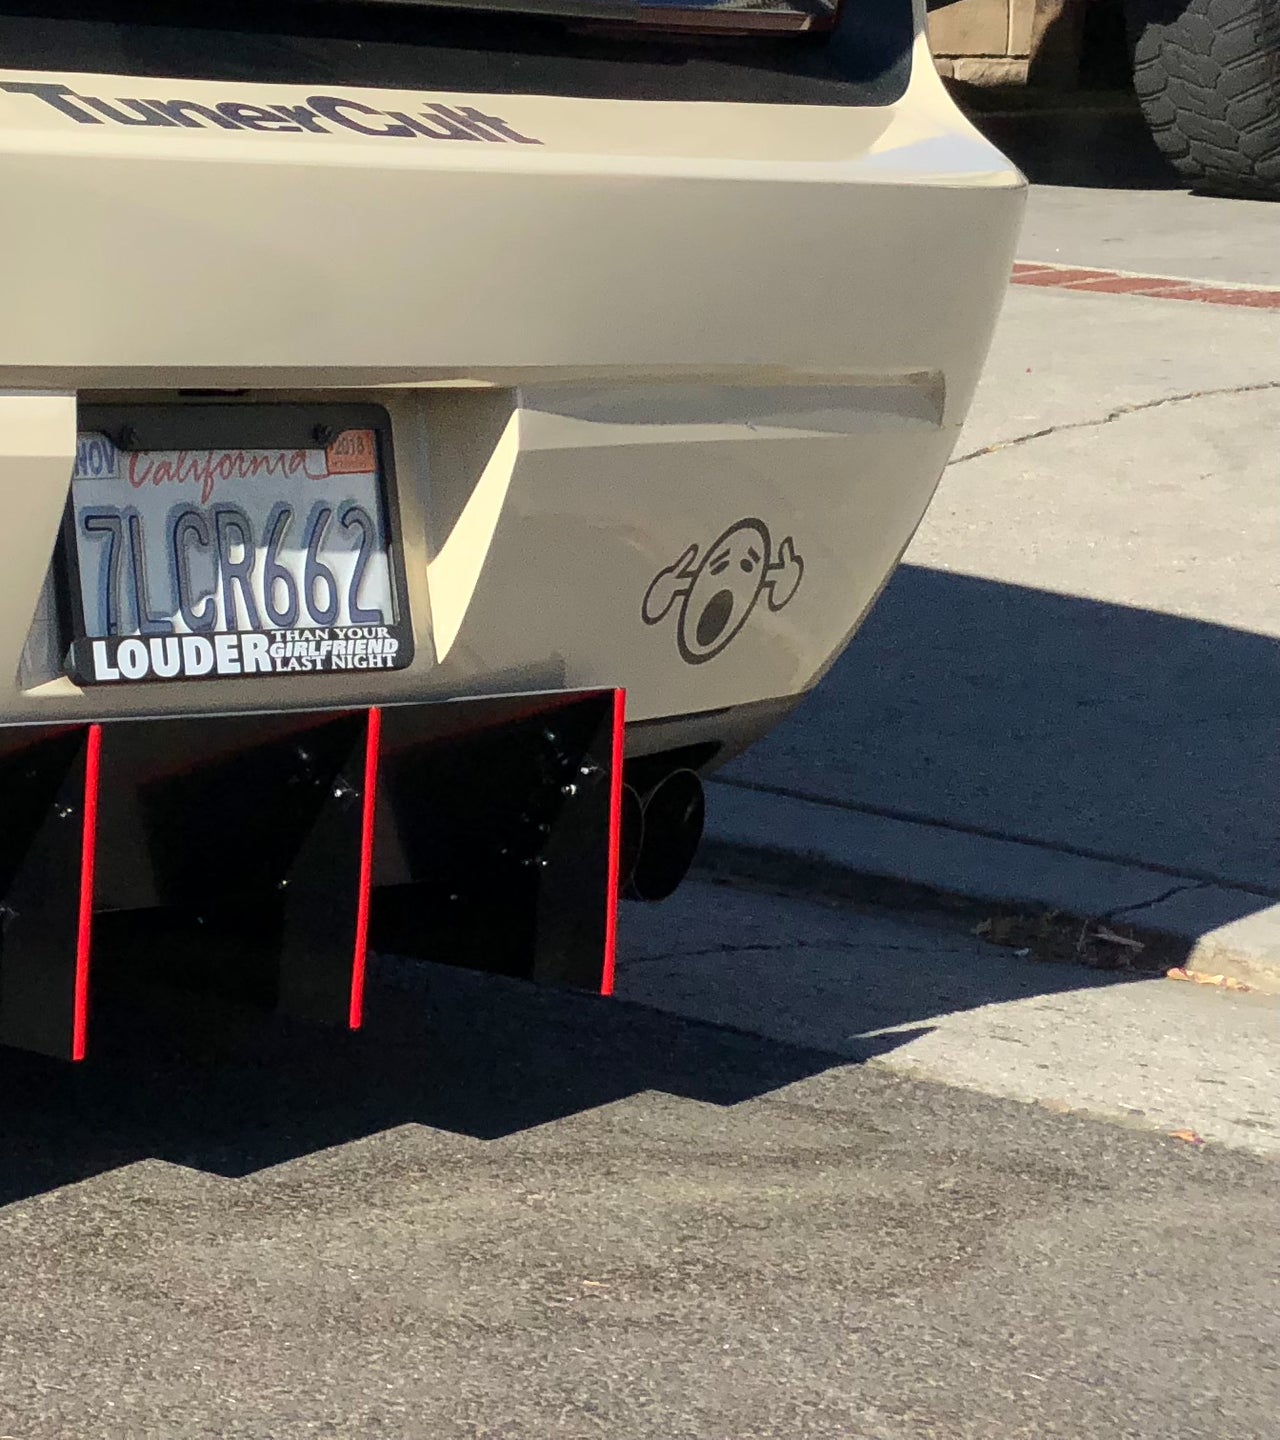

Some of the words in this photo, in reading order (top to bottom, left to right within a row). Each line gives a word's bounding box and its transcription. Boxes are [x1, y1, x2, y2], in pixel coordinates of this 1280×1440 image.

[75, 441, 115, 477] NOV
[128, 448, 331, 503] California
[82, 502, 383, 634] 7LCR662
[269, 638, 399, 657] GIRLFRIEND
[271, 629, 329, 641] THAN
[334, 627, 391, 639] YOUR
[93, 633, 273, 680] LOUDER
[275, 655, 325, 671] LAST
[331, 653, 396, 669] NIGHT
